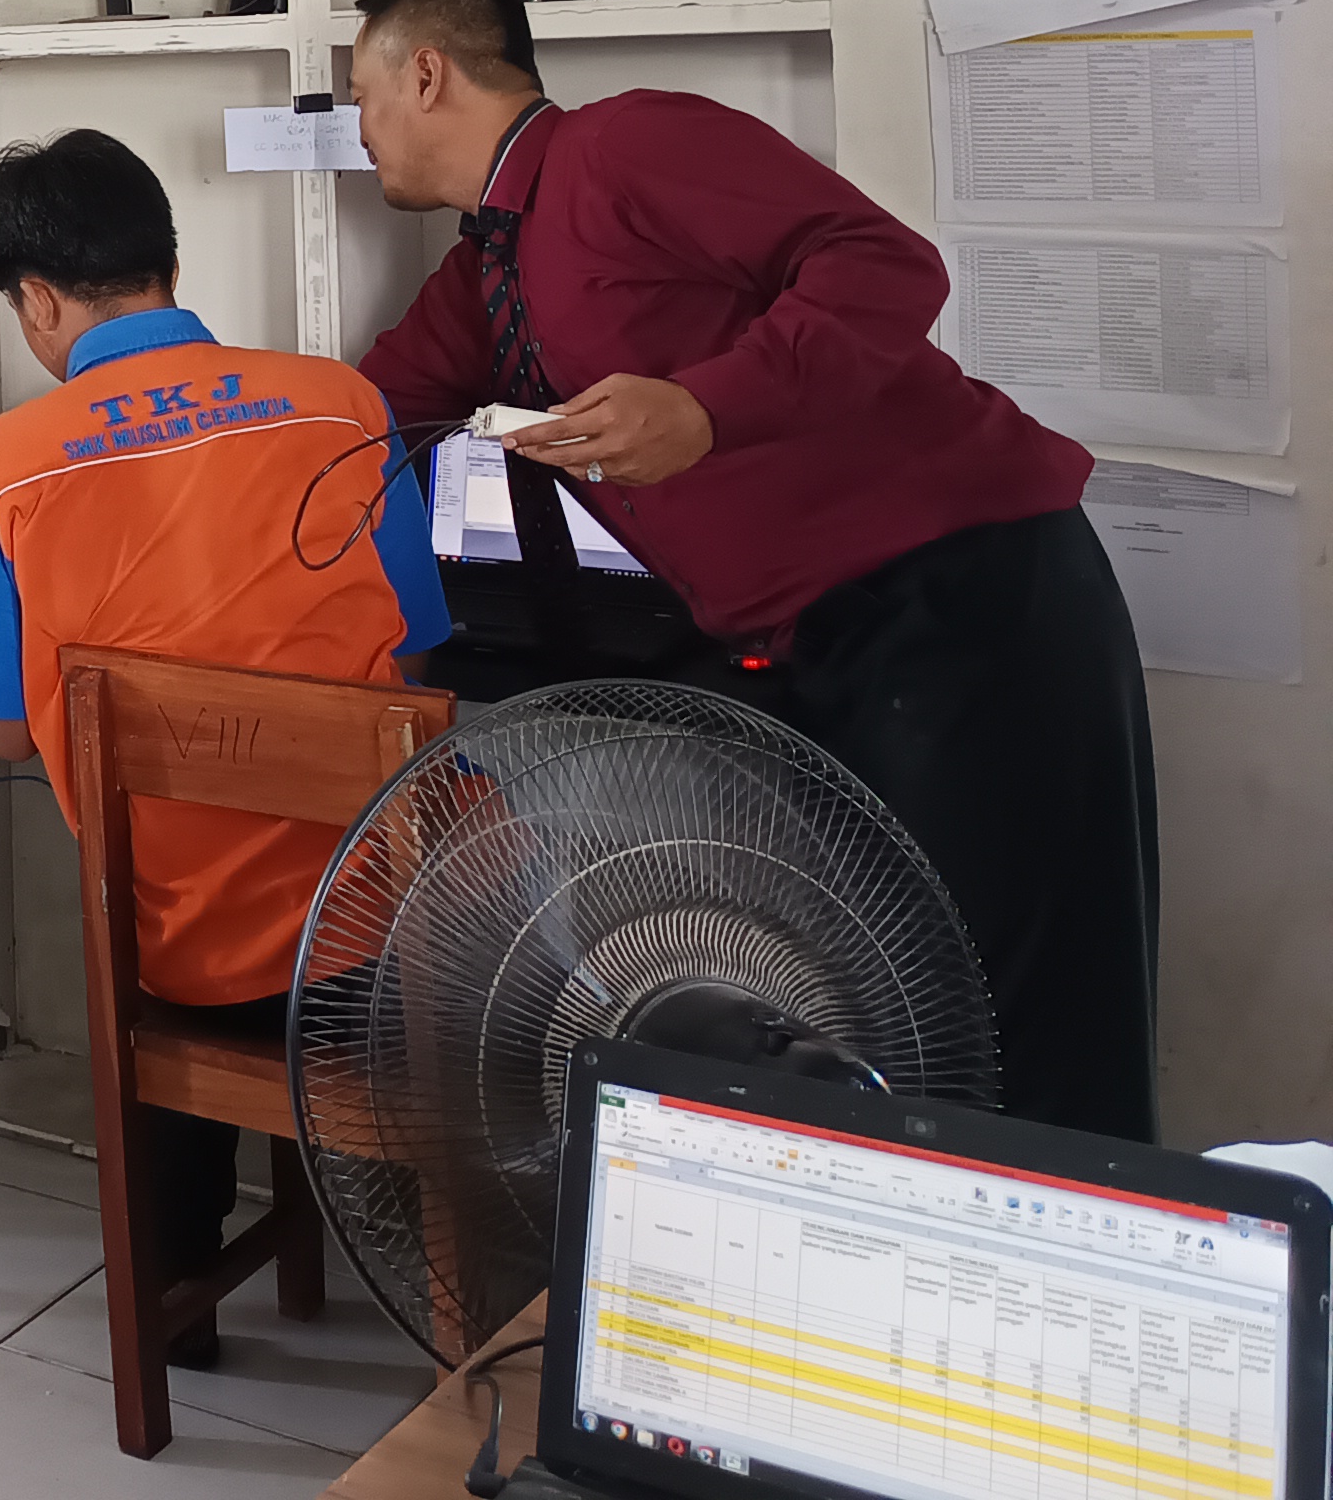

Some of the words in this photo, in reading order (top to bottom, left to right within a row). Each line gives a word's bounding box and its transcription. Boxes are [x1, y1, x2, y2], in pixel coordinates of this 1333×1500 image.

[63, 431, 109, 460] SMK
[111, 414, 194, 450] MUSLIM
[195, 396, 296, 432] CENDIKIA
[157, 702, 261, 765] VIII
